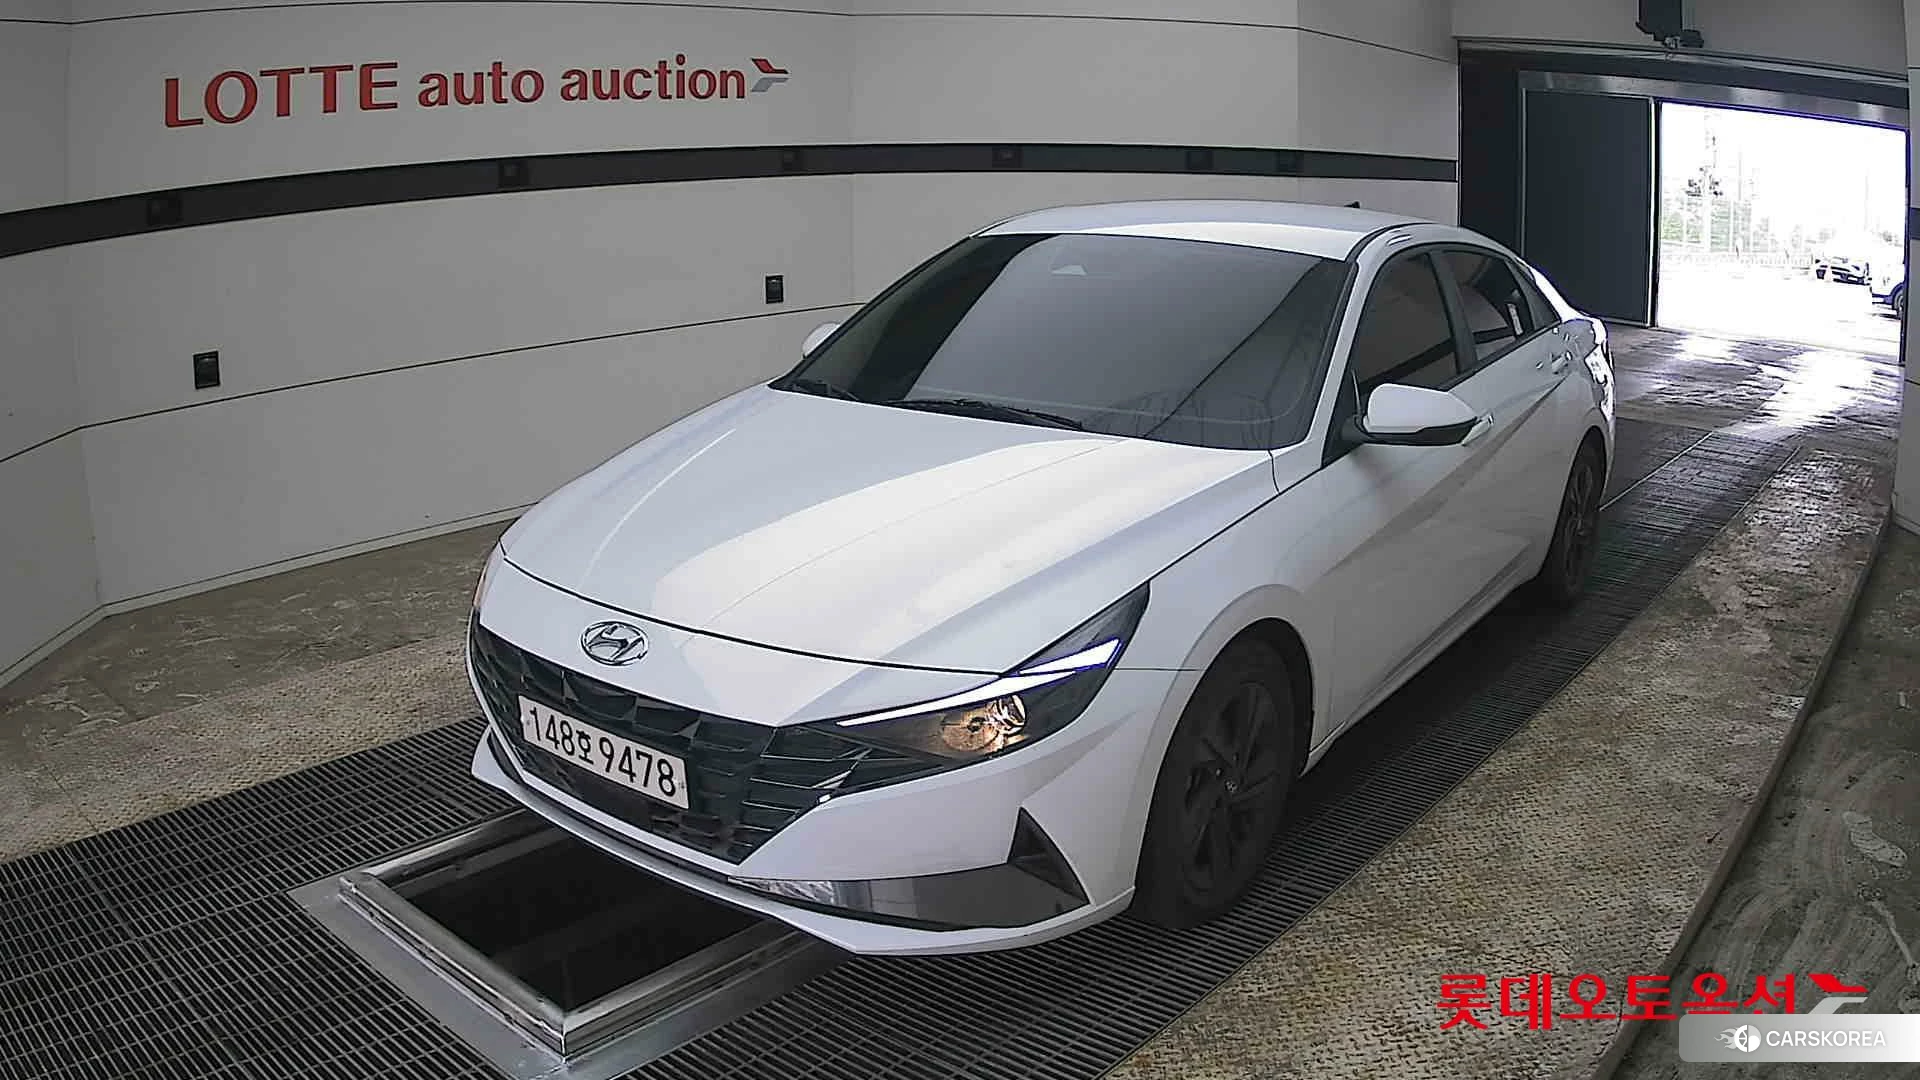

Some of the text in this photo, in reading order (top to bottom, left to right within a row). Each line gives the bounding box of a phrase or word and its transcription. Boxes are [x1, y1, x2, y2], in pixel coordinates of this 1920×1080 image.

[164, 53, 747, 127] LOTTE auto auction
